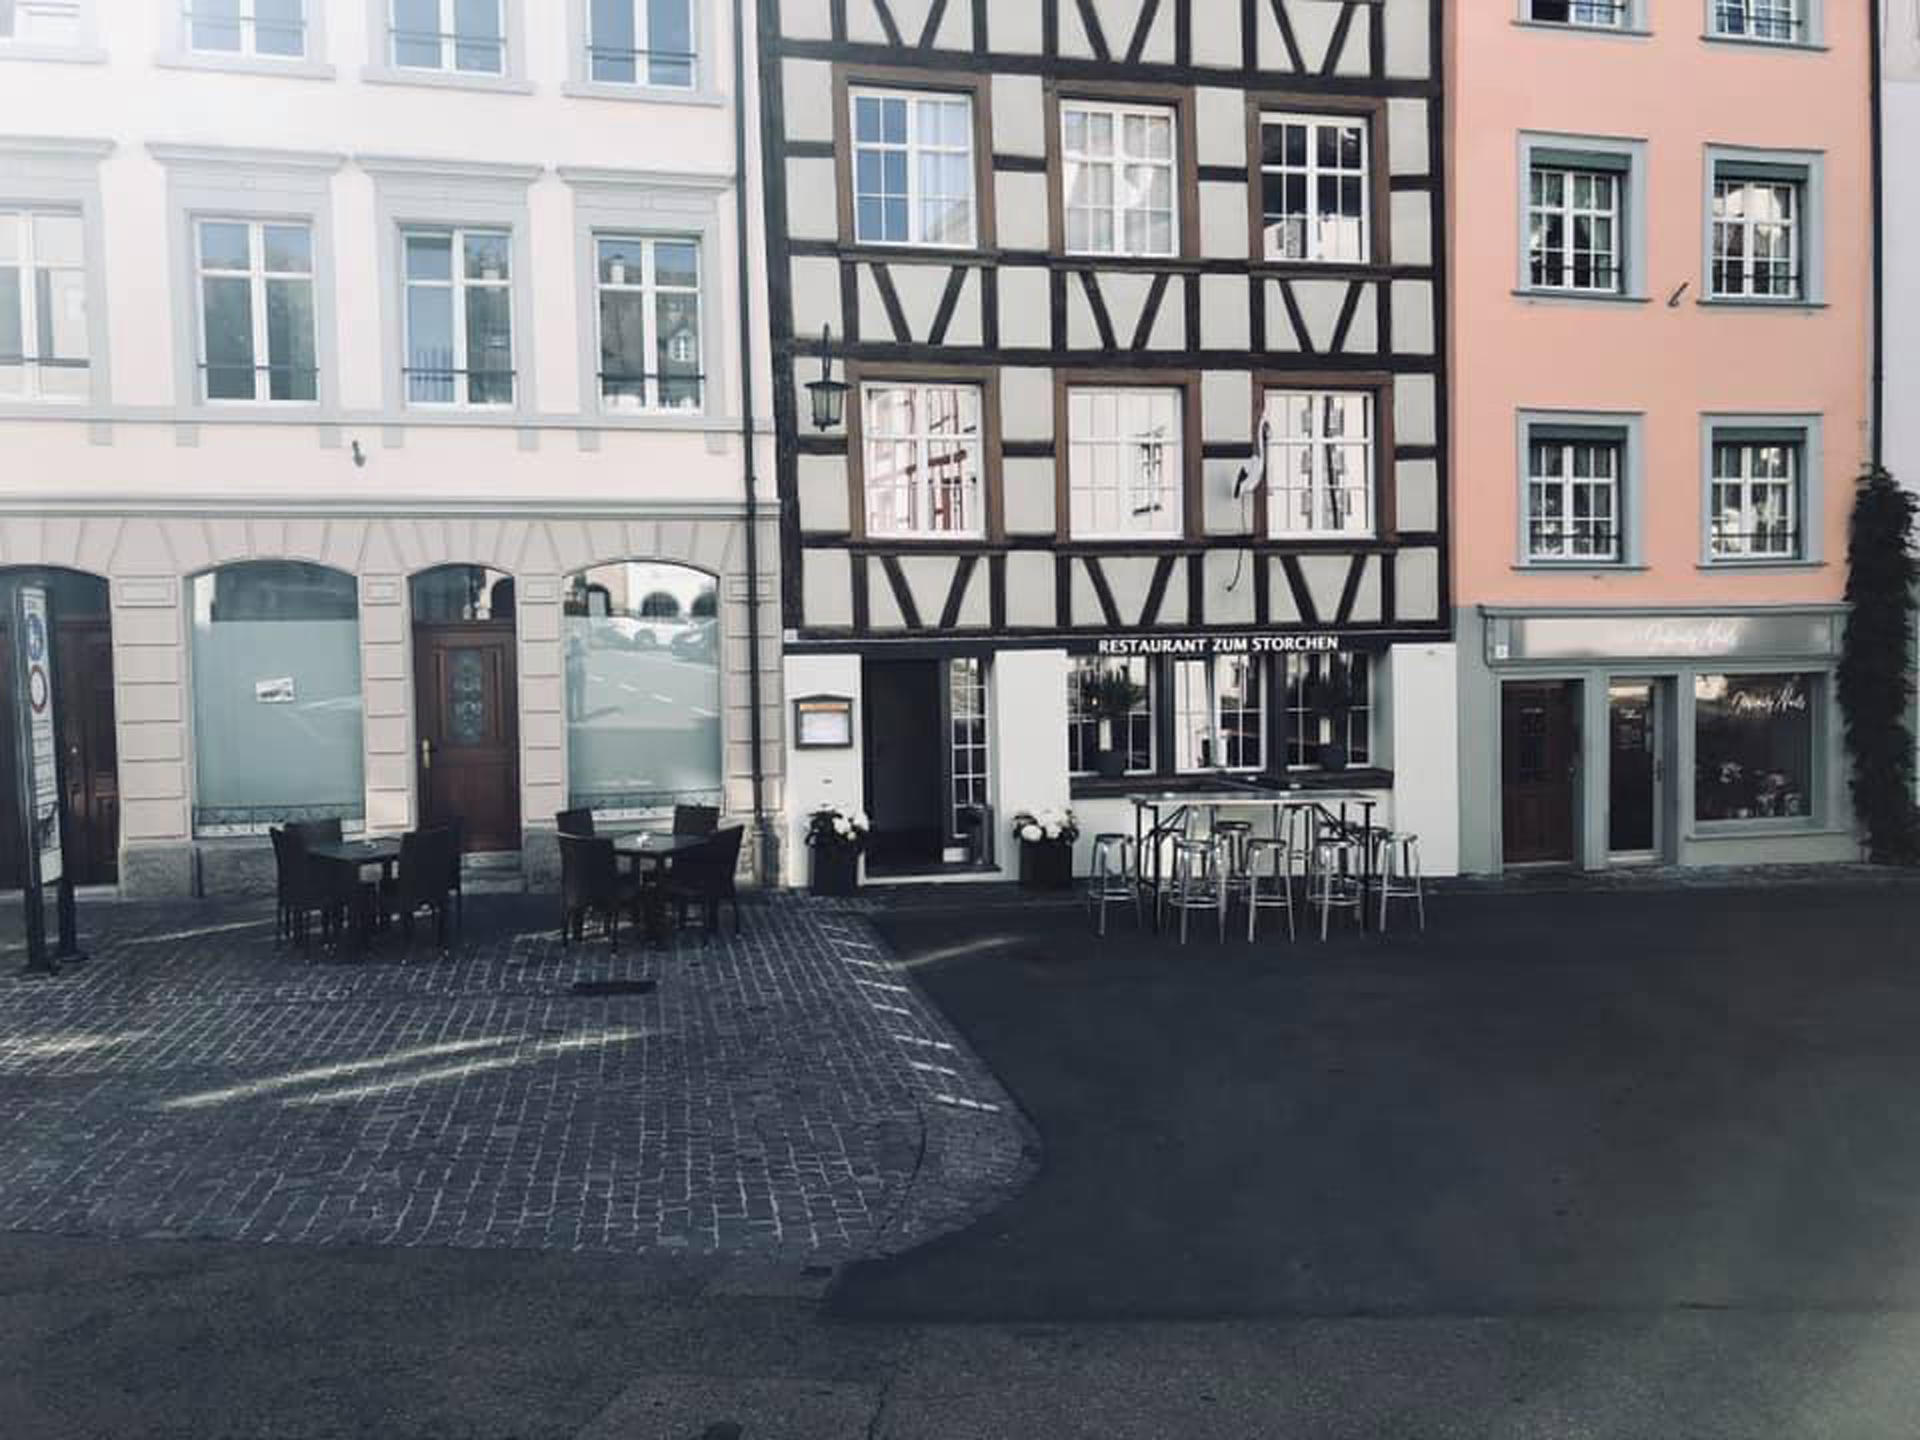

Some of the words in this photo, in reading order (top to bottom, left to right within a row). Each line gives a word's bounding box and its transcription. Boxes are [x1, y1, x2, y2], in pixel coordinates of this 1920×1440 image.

[1098, 638, 1206, 653] RESTAURANT
[1212, 637, 1248, 651] ZUM
[1252, 635, 1339, 651] STORCHEN
